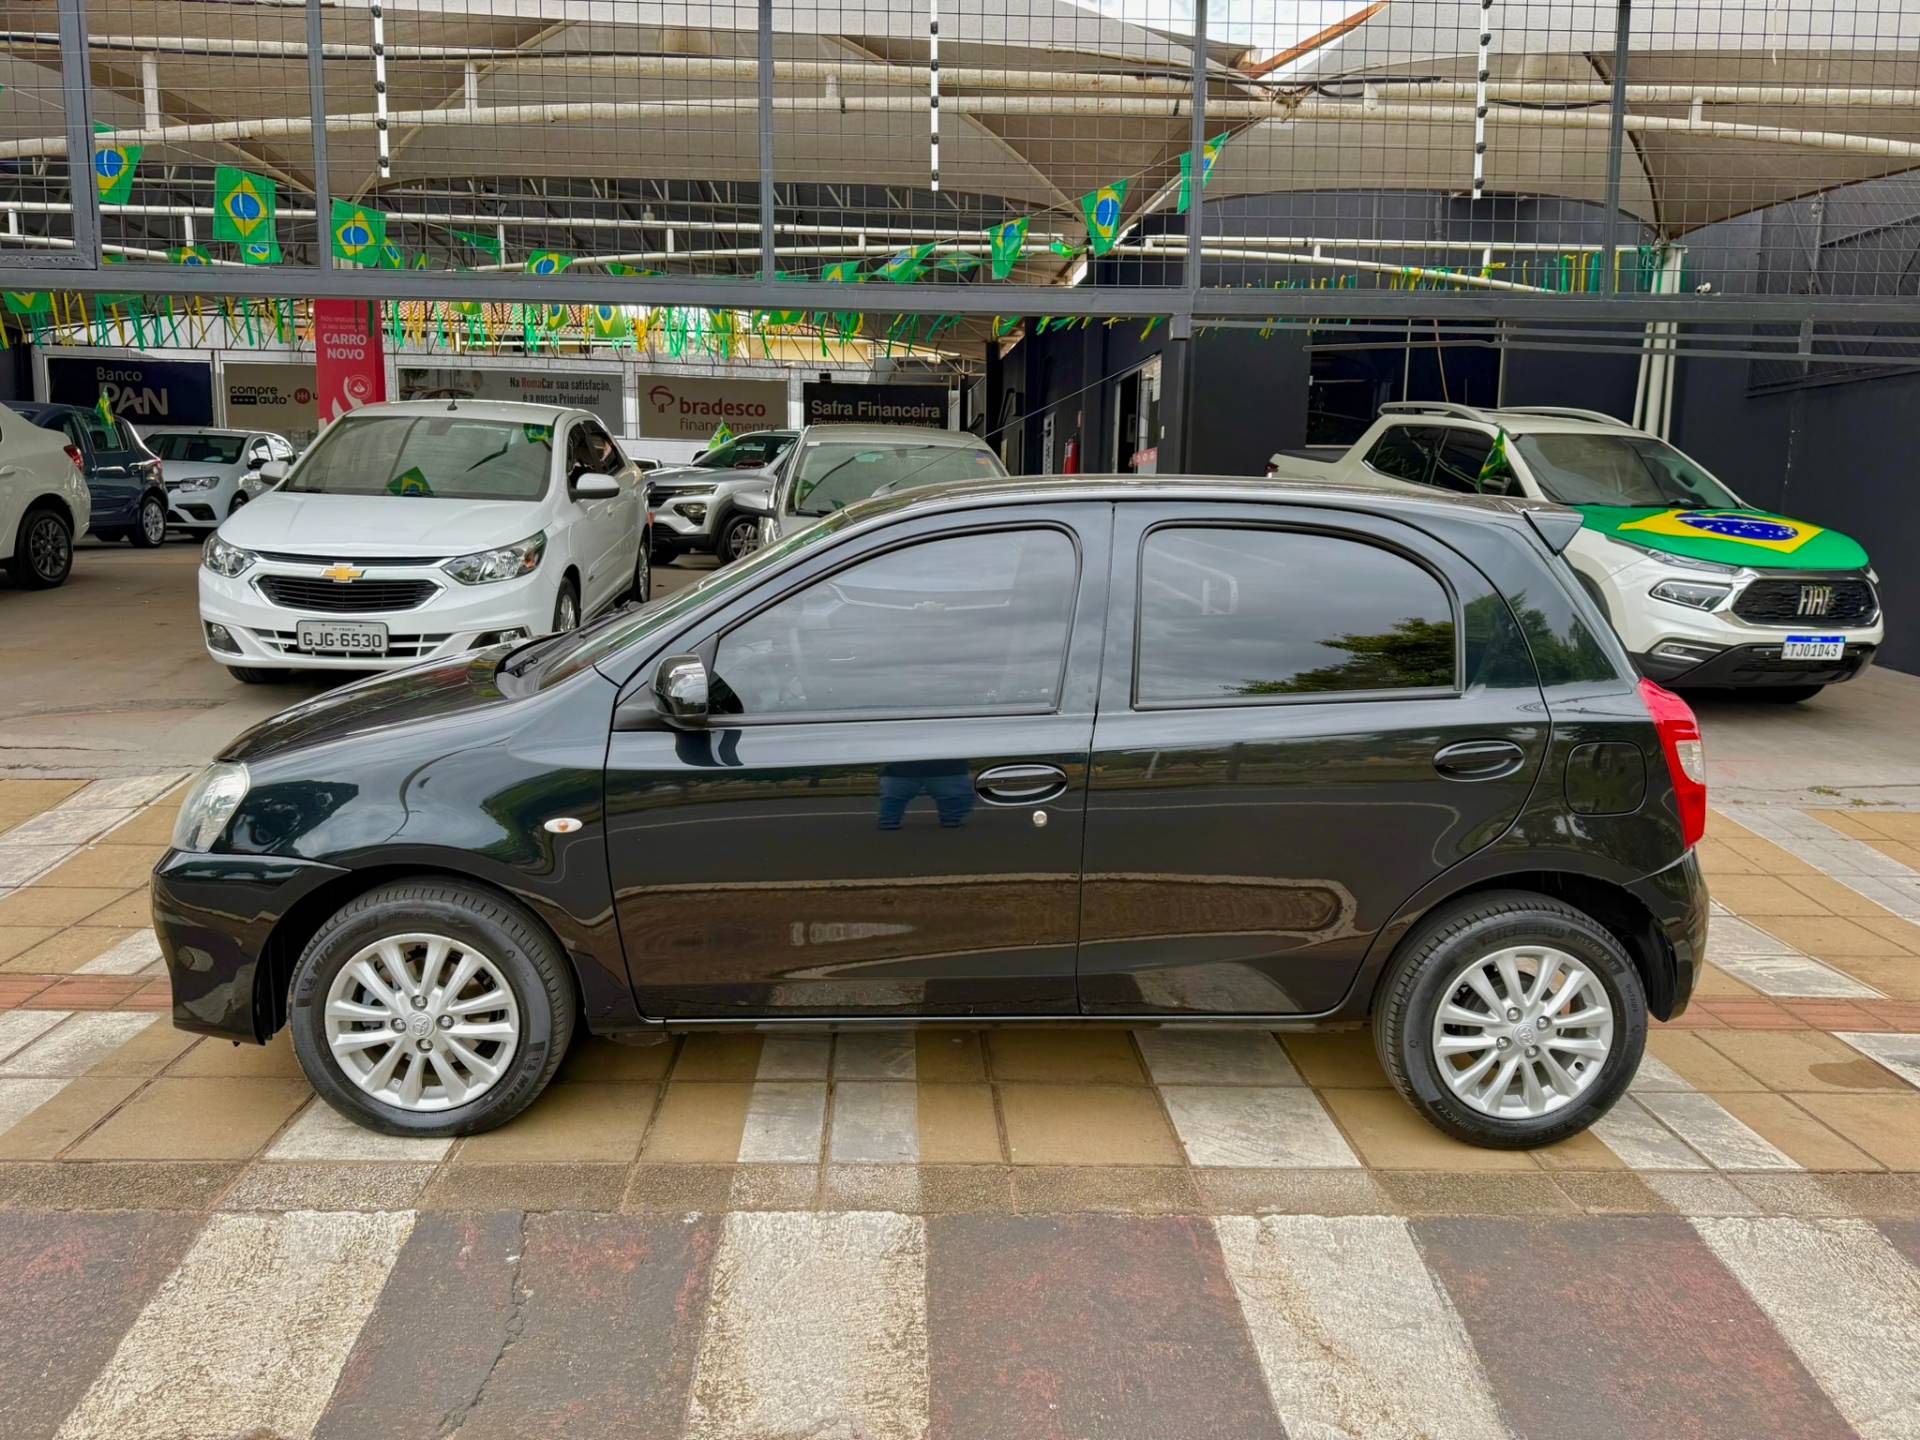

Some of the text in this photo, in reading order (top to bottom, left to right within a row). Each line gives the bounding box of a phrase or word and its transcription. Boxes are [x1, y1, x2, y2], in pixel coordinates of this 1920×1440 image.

[323, 332, 367, 346] CARRO
[327, 348, 365, 360] NOVO
[96, 366, 143, 382] Banco
[509, 376, 520, 388] Na
[556, 381, 569, 390] sua
[229, 385, 278, 397] compre
[98, 382, 168, 416] PAN
[258, 395, 287, 405] auto
[679, 396, 766, 417] bradesco
[811, 400, 940, 418] Safra Financeira
[1797, 585, 1833, 615] FIAT
